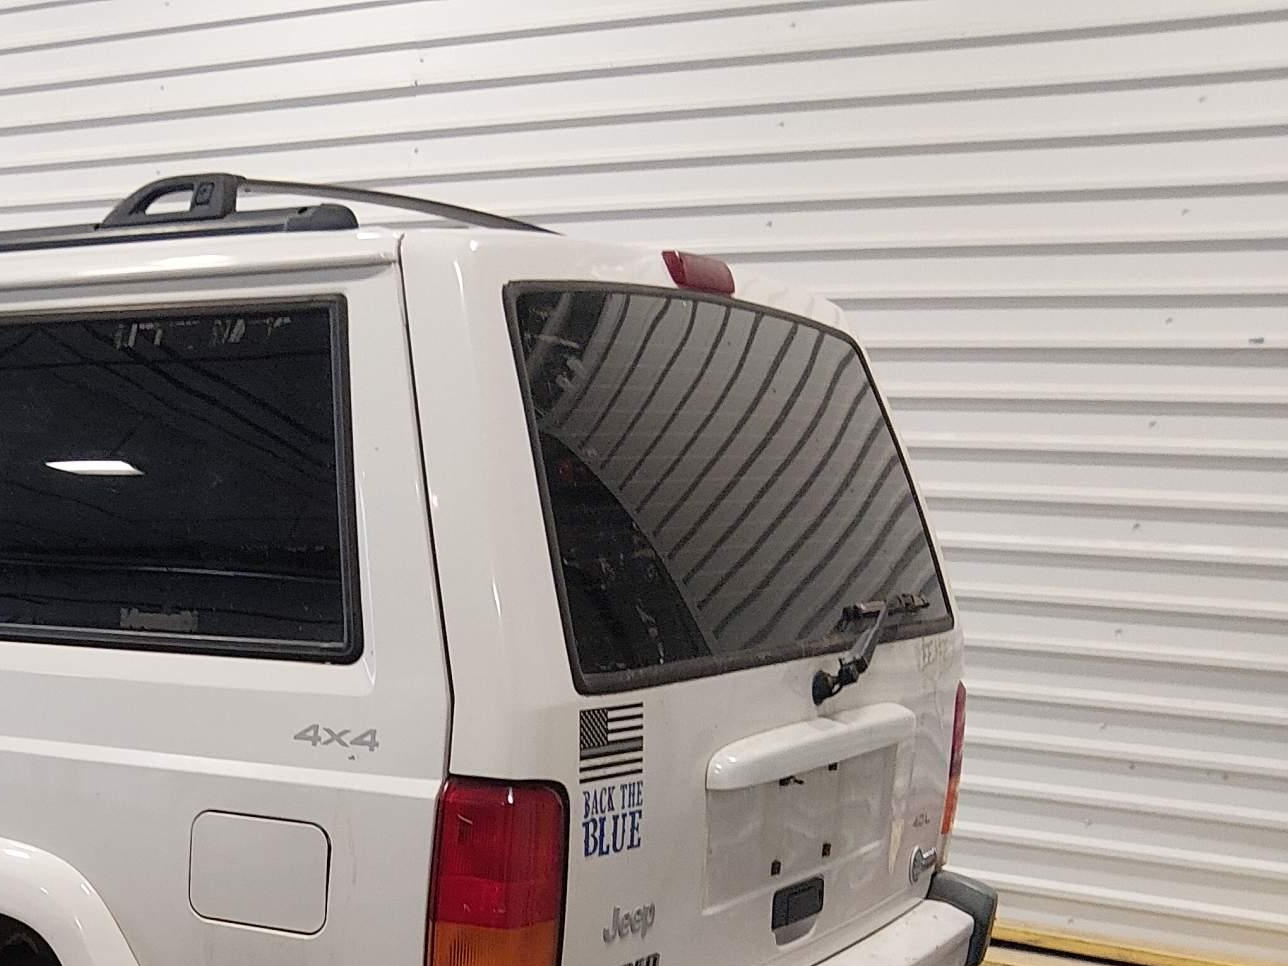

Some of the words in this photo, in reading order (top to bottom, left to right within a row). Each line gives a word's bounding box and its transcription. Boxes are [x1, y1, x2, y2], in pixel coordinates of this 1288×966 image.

[583, 785, 616, 819] BACK
[620, 780, 644, 810] THE
[582, 809, 643, 858] BLUE
[602, 902, 656, 944] Jeep
